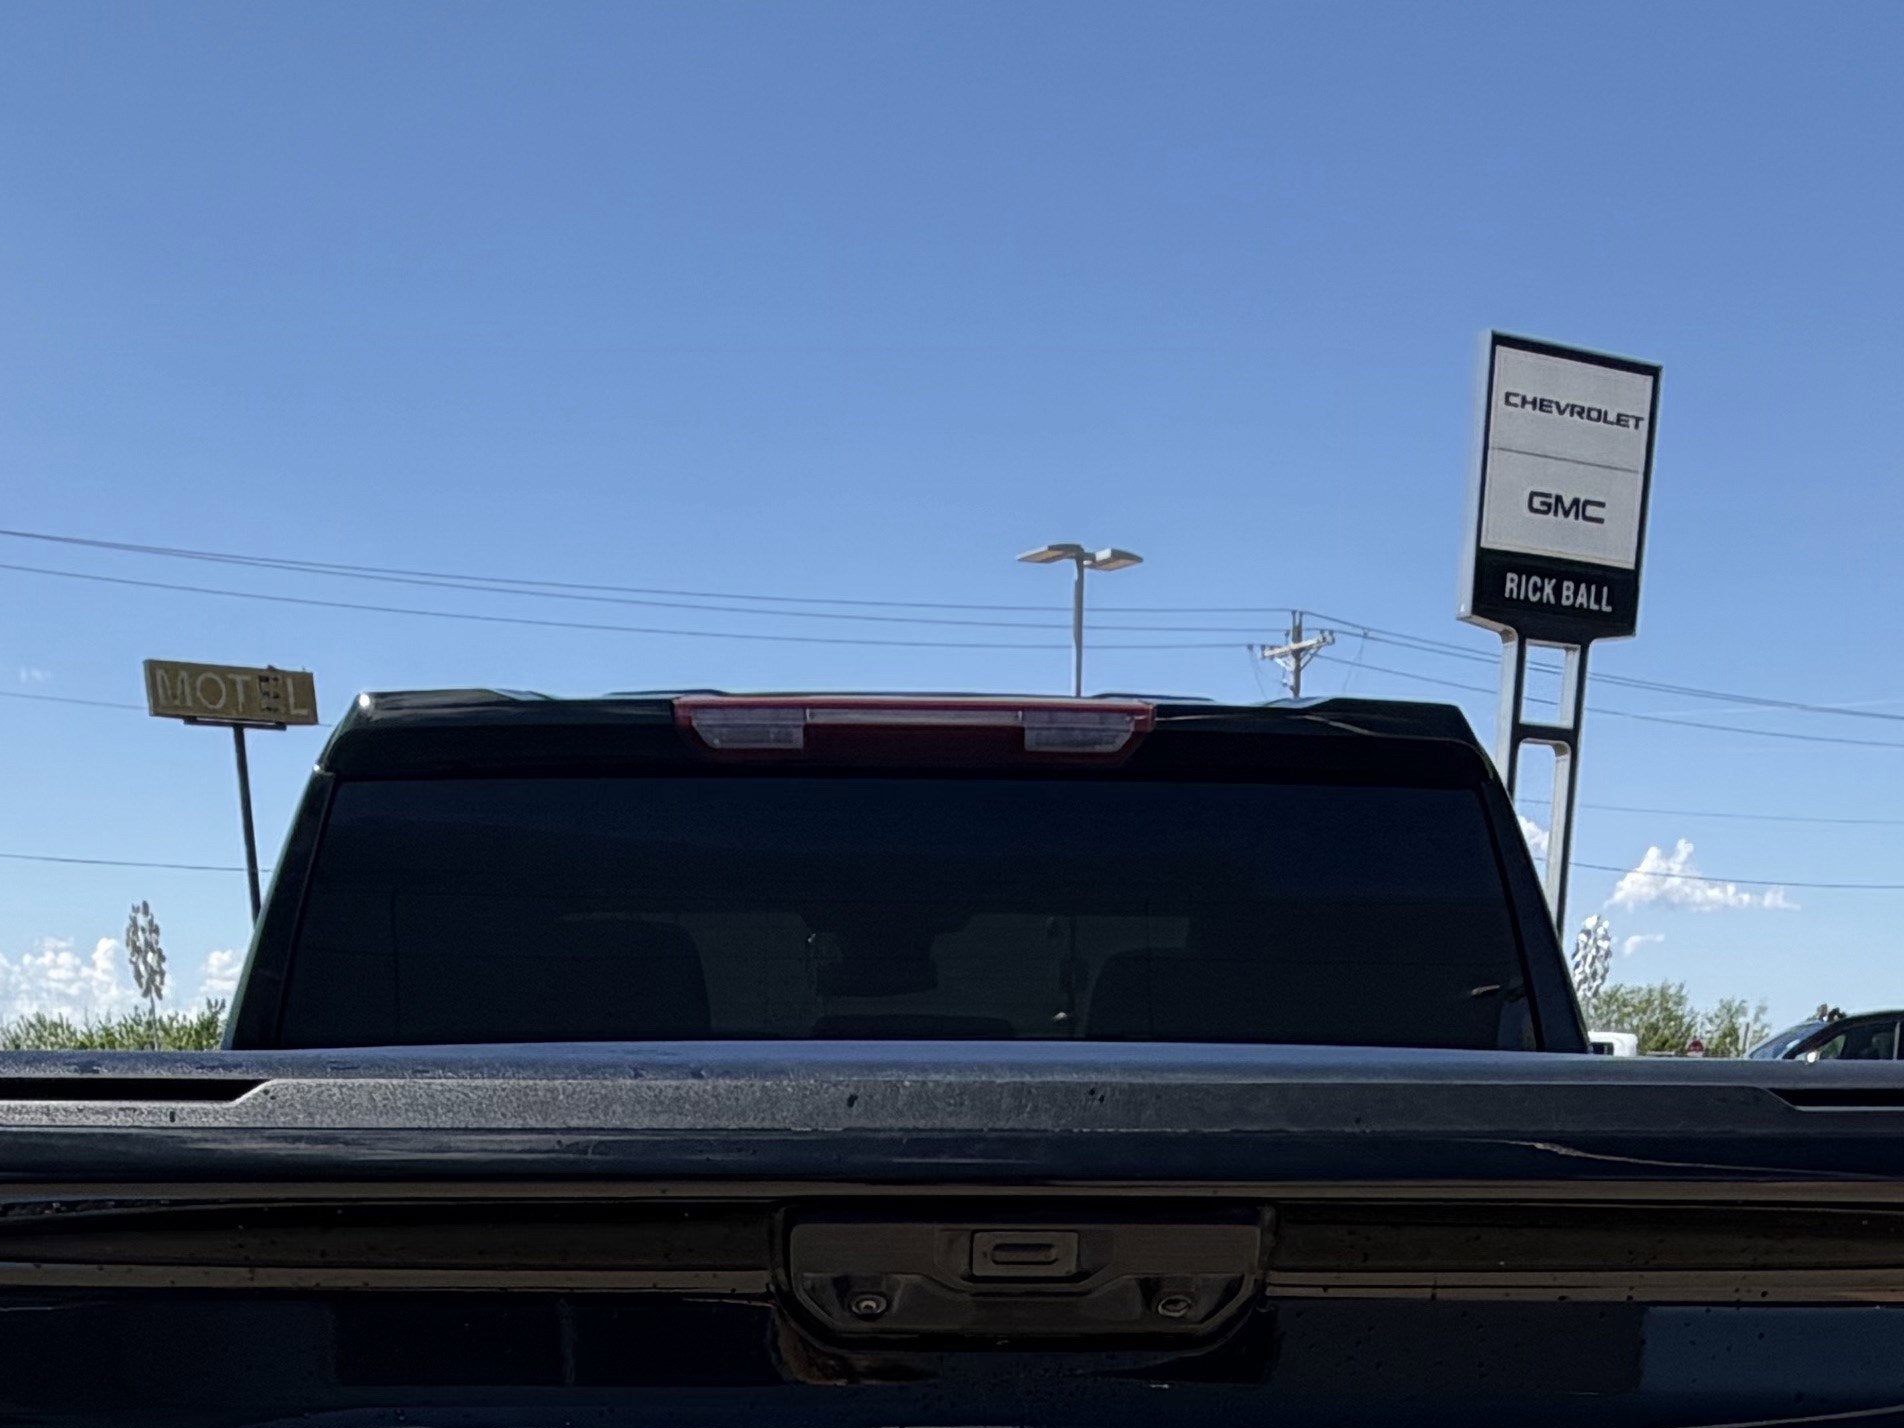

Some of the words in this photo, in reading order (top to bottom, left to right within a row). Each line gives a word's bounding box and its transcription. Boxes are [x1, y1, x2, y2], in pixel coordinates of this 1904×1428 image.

[1504, 391, 1645, 430] CHEVROLET
[1527, 490, 1607, 525] GMC
[1504, 572, 1556, 605] RICK
[1560, 581, 1613, 613] BALL
